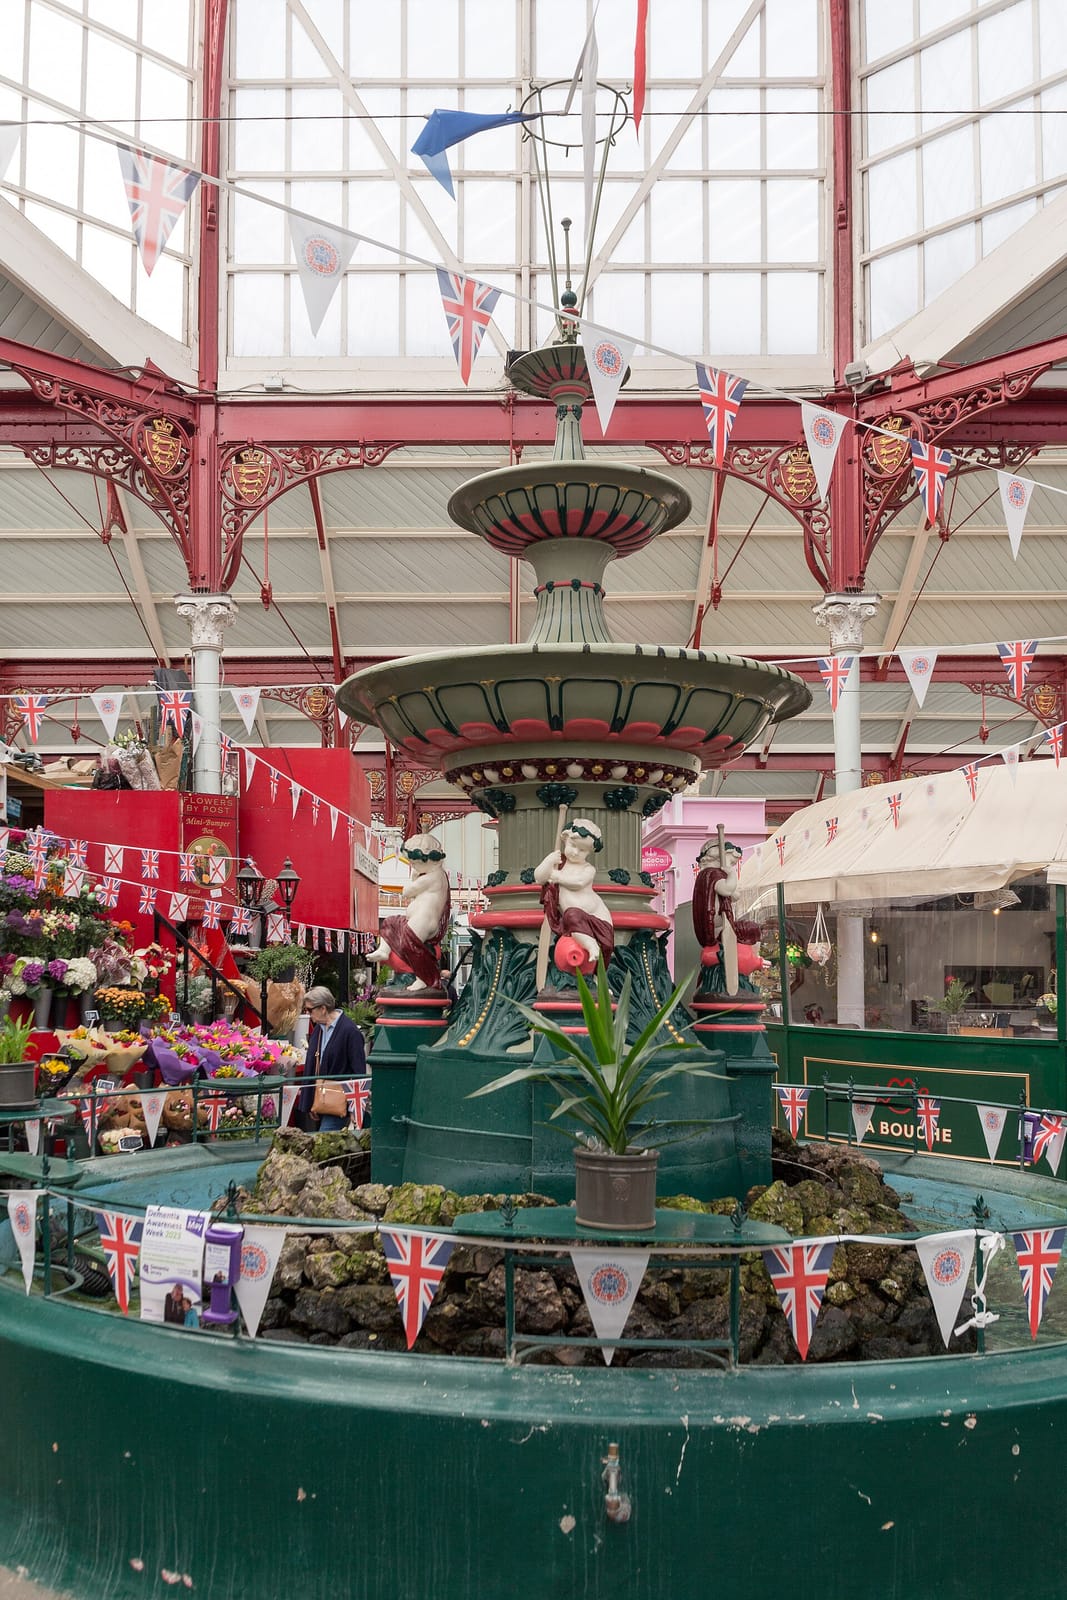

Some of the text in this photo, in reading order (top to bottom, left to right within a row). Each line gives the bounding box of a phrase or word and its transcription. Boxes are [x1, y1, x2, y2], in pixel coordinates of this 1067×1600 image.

[183, 796, 233, 807] FLOWERS
[187, 804, 231, 815] BY POST
[186, 817, 231, 829] Mini-Bumper
[147, 1209, 180, 1220] Dementia
[146, 1219, 182, 1230] Awareness
[187, 1220, 203, 1232] May
[145, 1229, 164, 1237] Week
